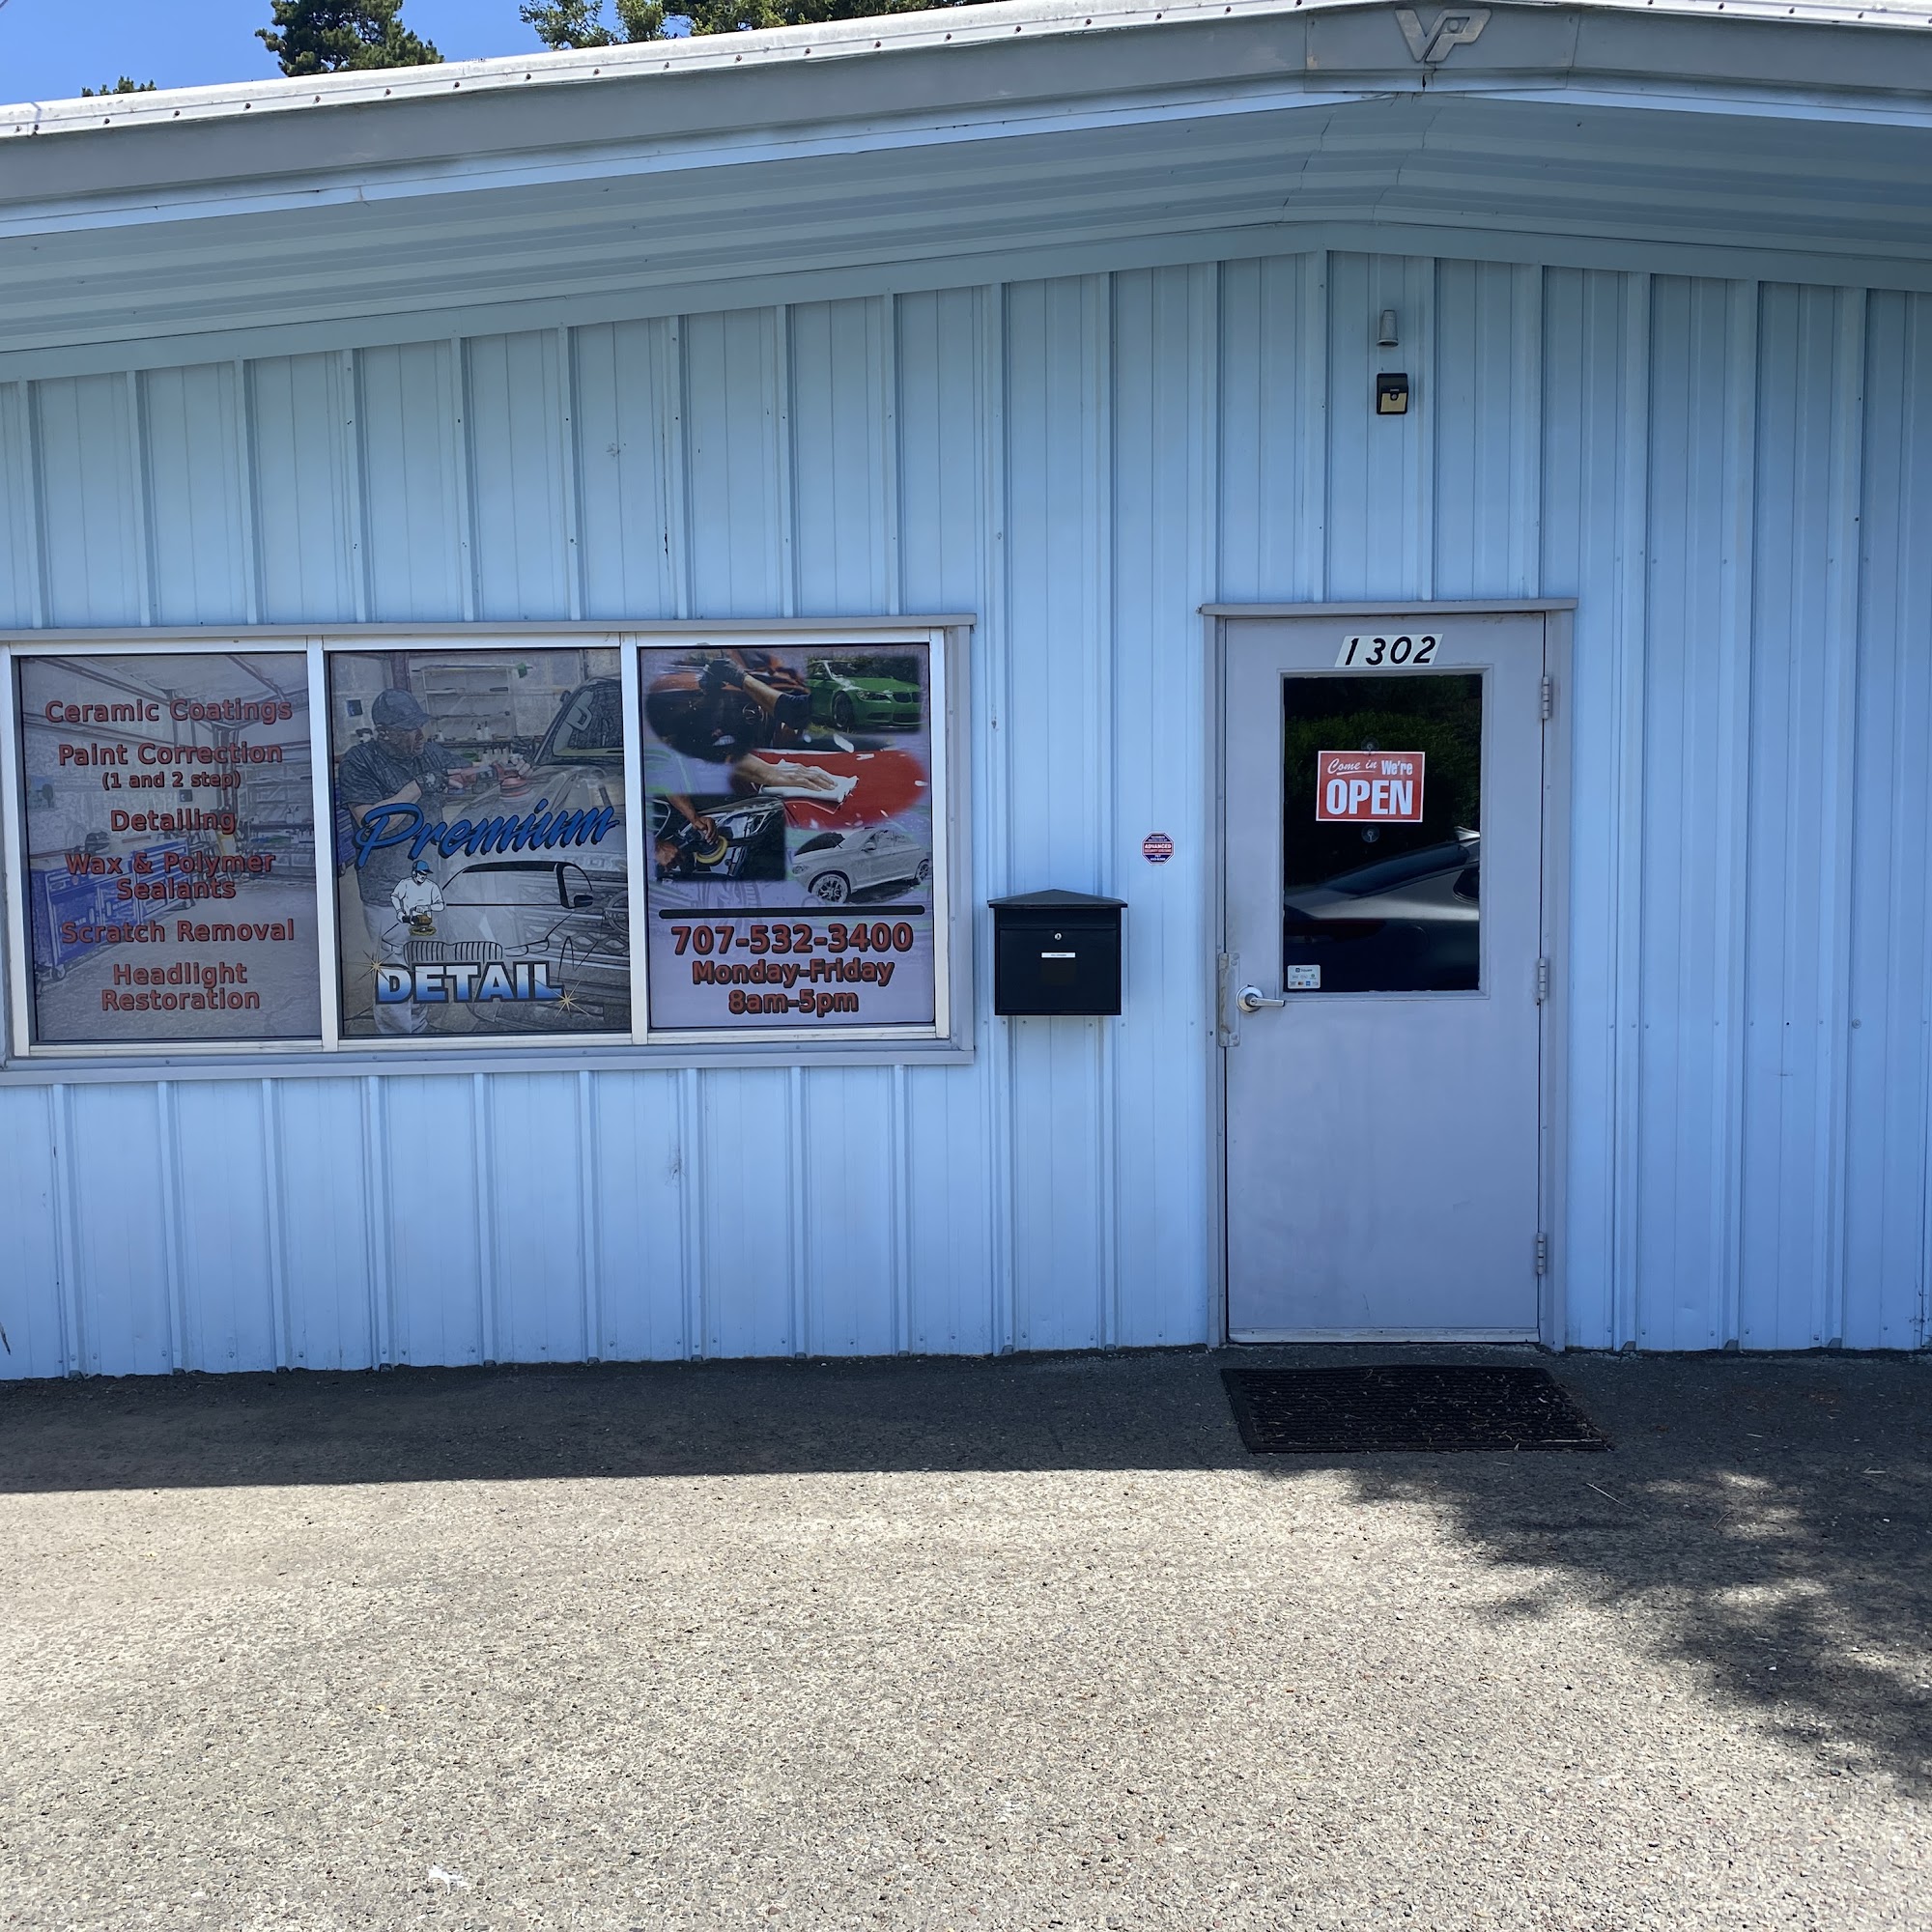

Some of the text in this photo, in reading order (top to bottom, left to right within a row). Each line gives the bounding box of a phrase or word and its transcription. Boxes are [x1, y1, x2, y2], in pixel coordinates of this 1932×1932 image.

[1346, 636, 1436, 666] 1302
[45, 697, 294, 724] Ceramic Coatings
[58, 741, 283, 765] Paint Correction
[1327, 757, 1413, 776] Come in We're
[101, 771, 242, 791] (1 and 2 step)
[1326, 779, 1413, 815] OPEN
[110, 809, 238, 835] Detailing
[355, 798, 619, 867] Premium
[65, 851, 276, 878] Wax & Polymer
[116, 877, 237, 900] Sealants
[61, 918, 295, 944] Scratch Removal
[671, 922, 914, 956] 707-532-3400
[113, 962, 248, 989] Headlight
[375, 961, 565, 1005] DETAIL
[692, 957, 895, 987] Monday-Friday
[101, 987, 261, 1011] Restoration
[728, 988, 859, 1017] 8am-5pm
